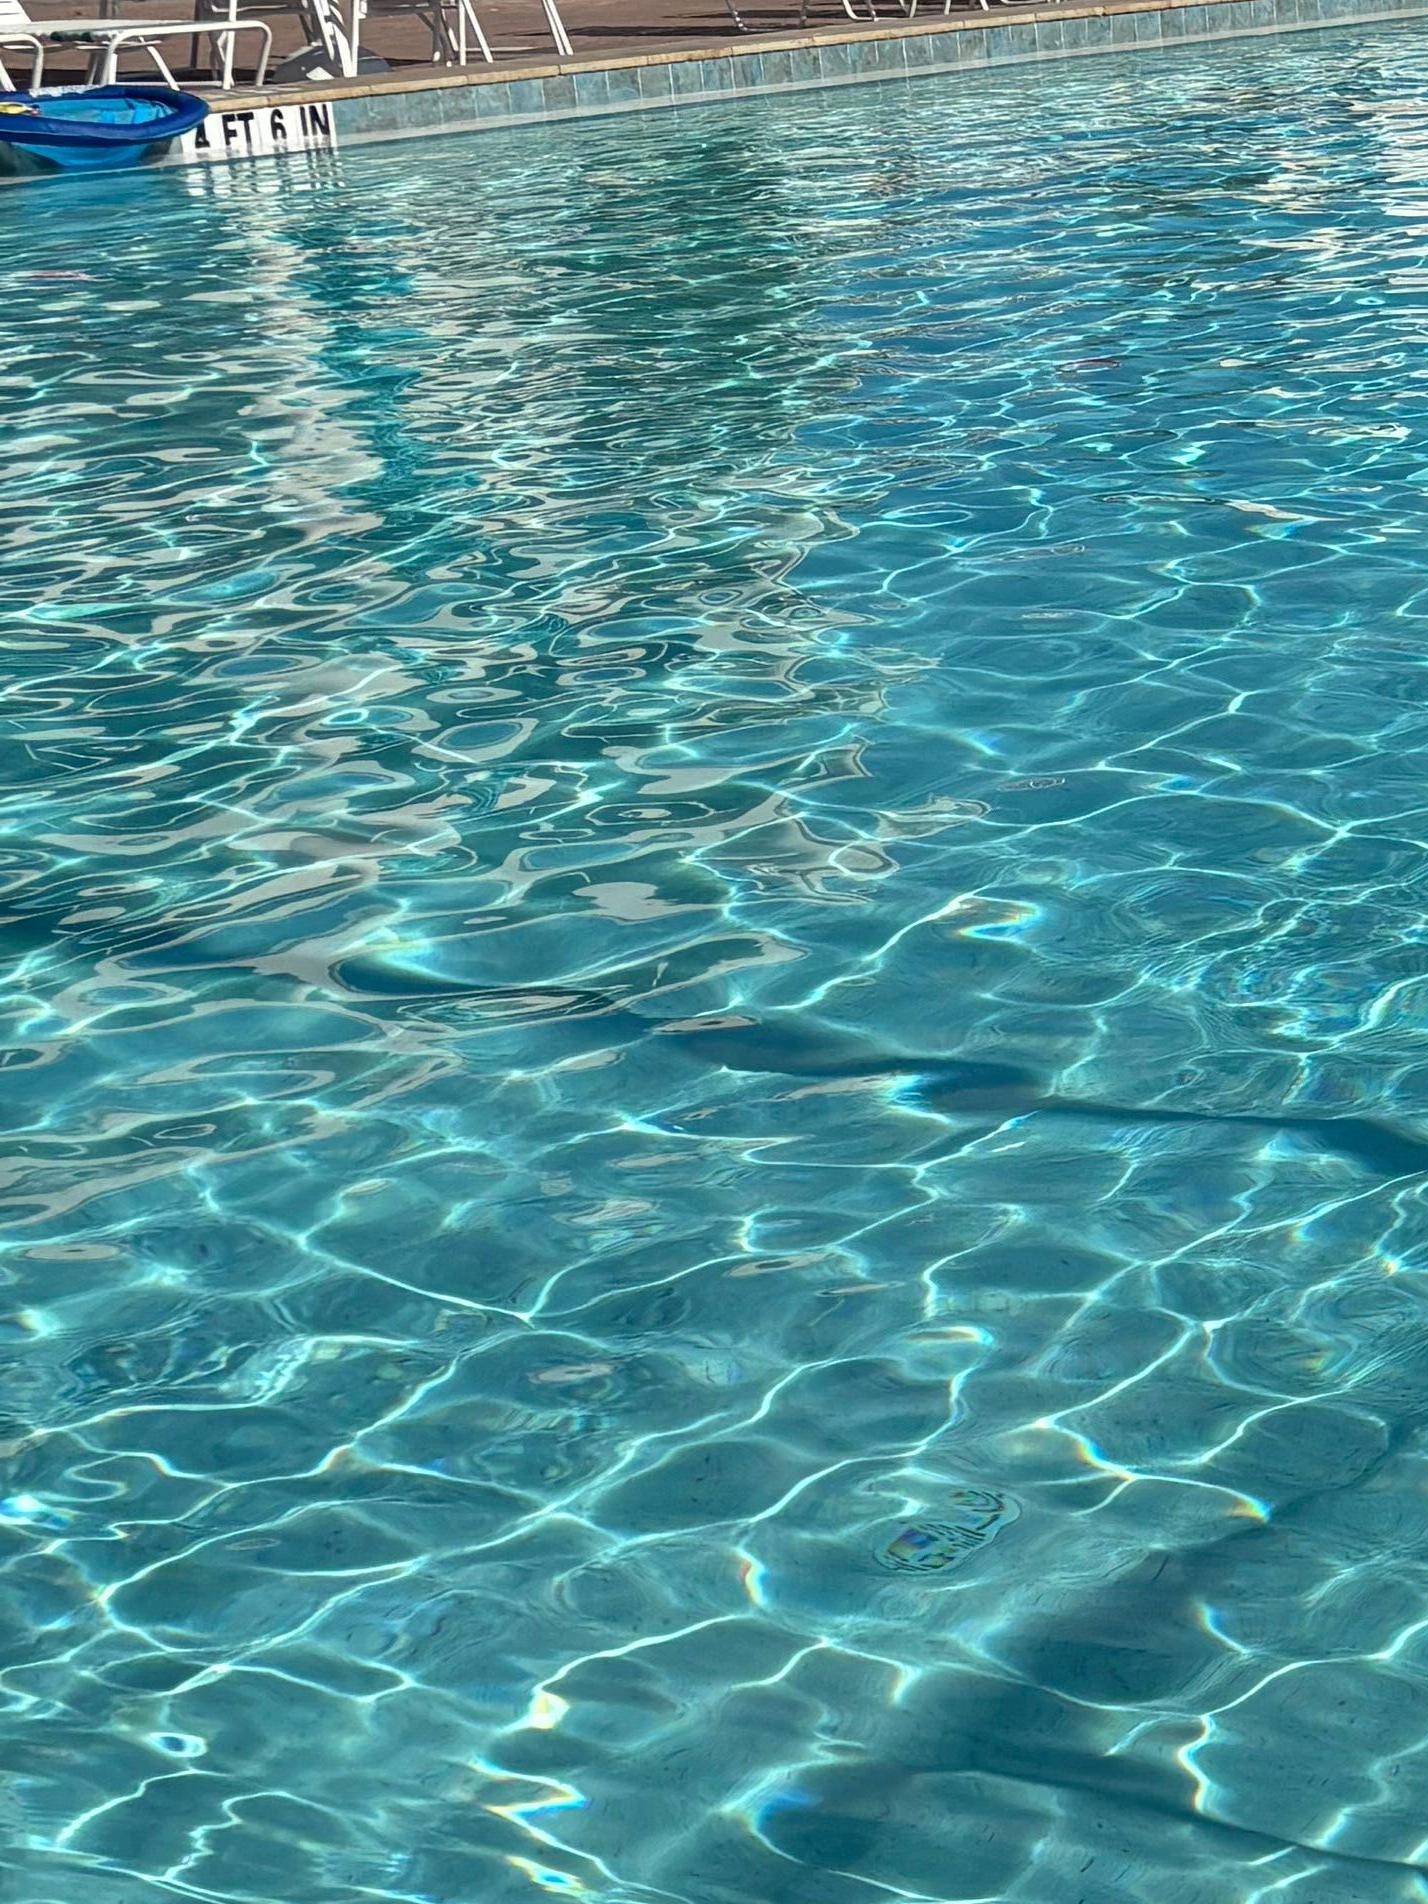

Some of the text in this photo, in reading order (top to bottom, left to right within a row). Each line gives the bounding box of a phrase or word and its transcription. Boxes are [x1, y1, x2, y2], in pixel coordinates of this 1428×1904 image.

[222, 111, 254, 147] FT
[270, 108, 288, 142] 6
[299, 103, 331, 138] IN
